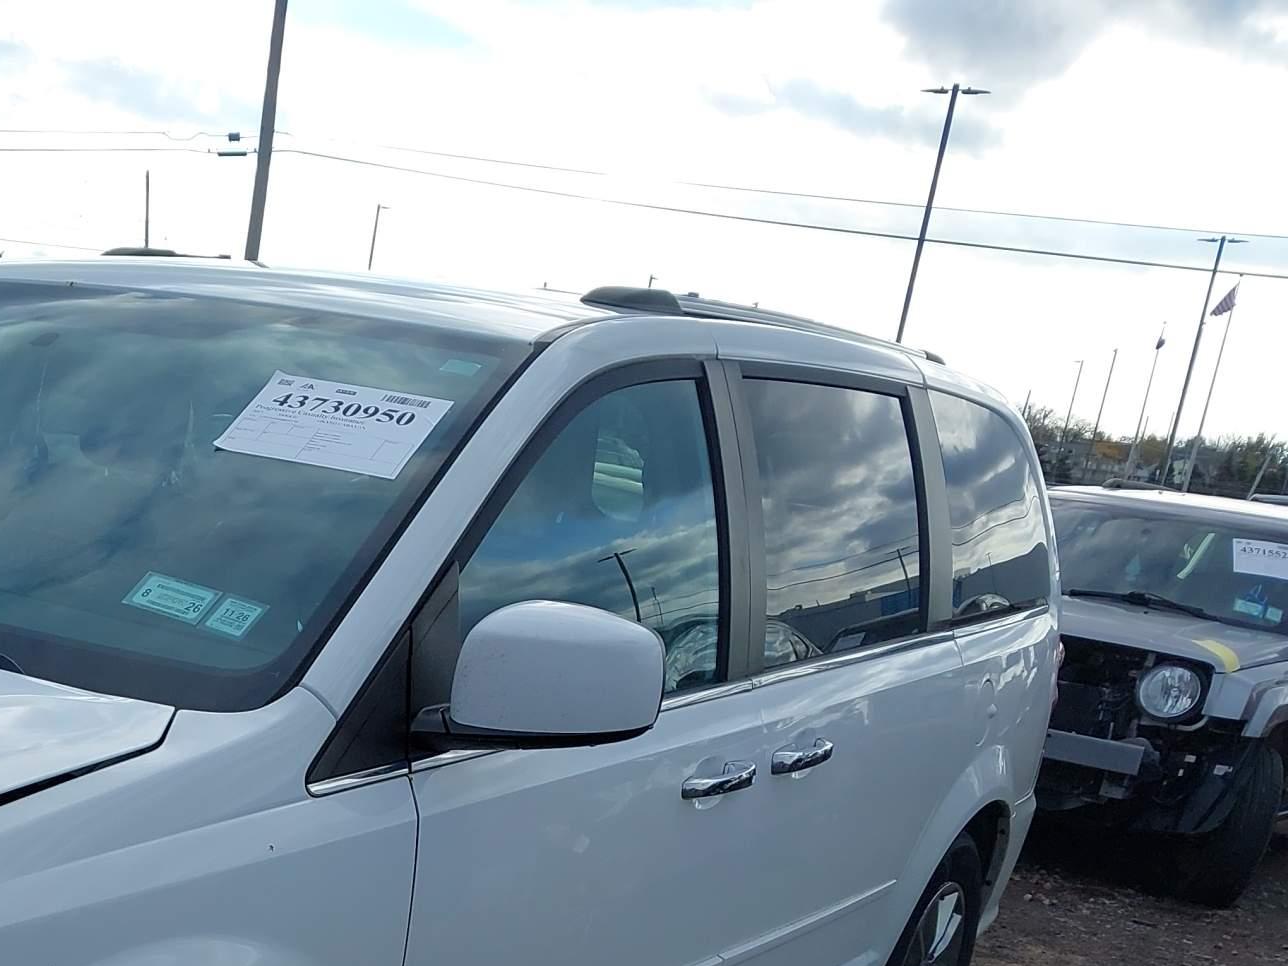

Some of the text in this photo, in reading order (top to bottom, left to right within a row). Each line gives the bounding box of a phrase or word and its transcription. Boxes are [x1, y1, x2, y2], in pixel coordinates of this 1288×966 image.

[272, 392, 416, 426] 43730950
[1240, 546, 1288, 559] 4371552
[141, 588, 152, 598] 8
[184, 602, 203, 614] 26
